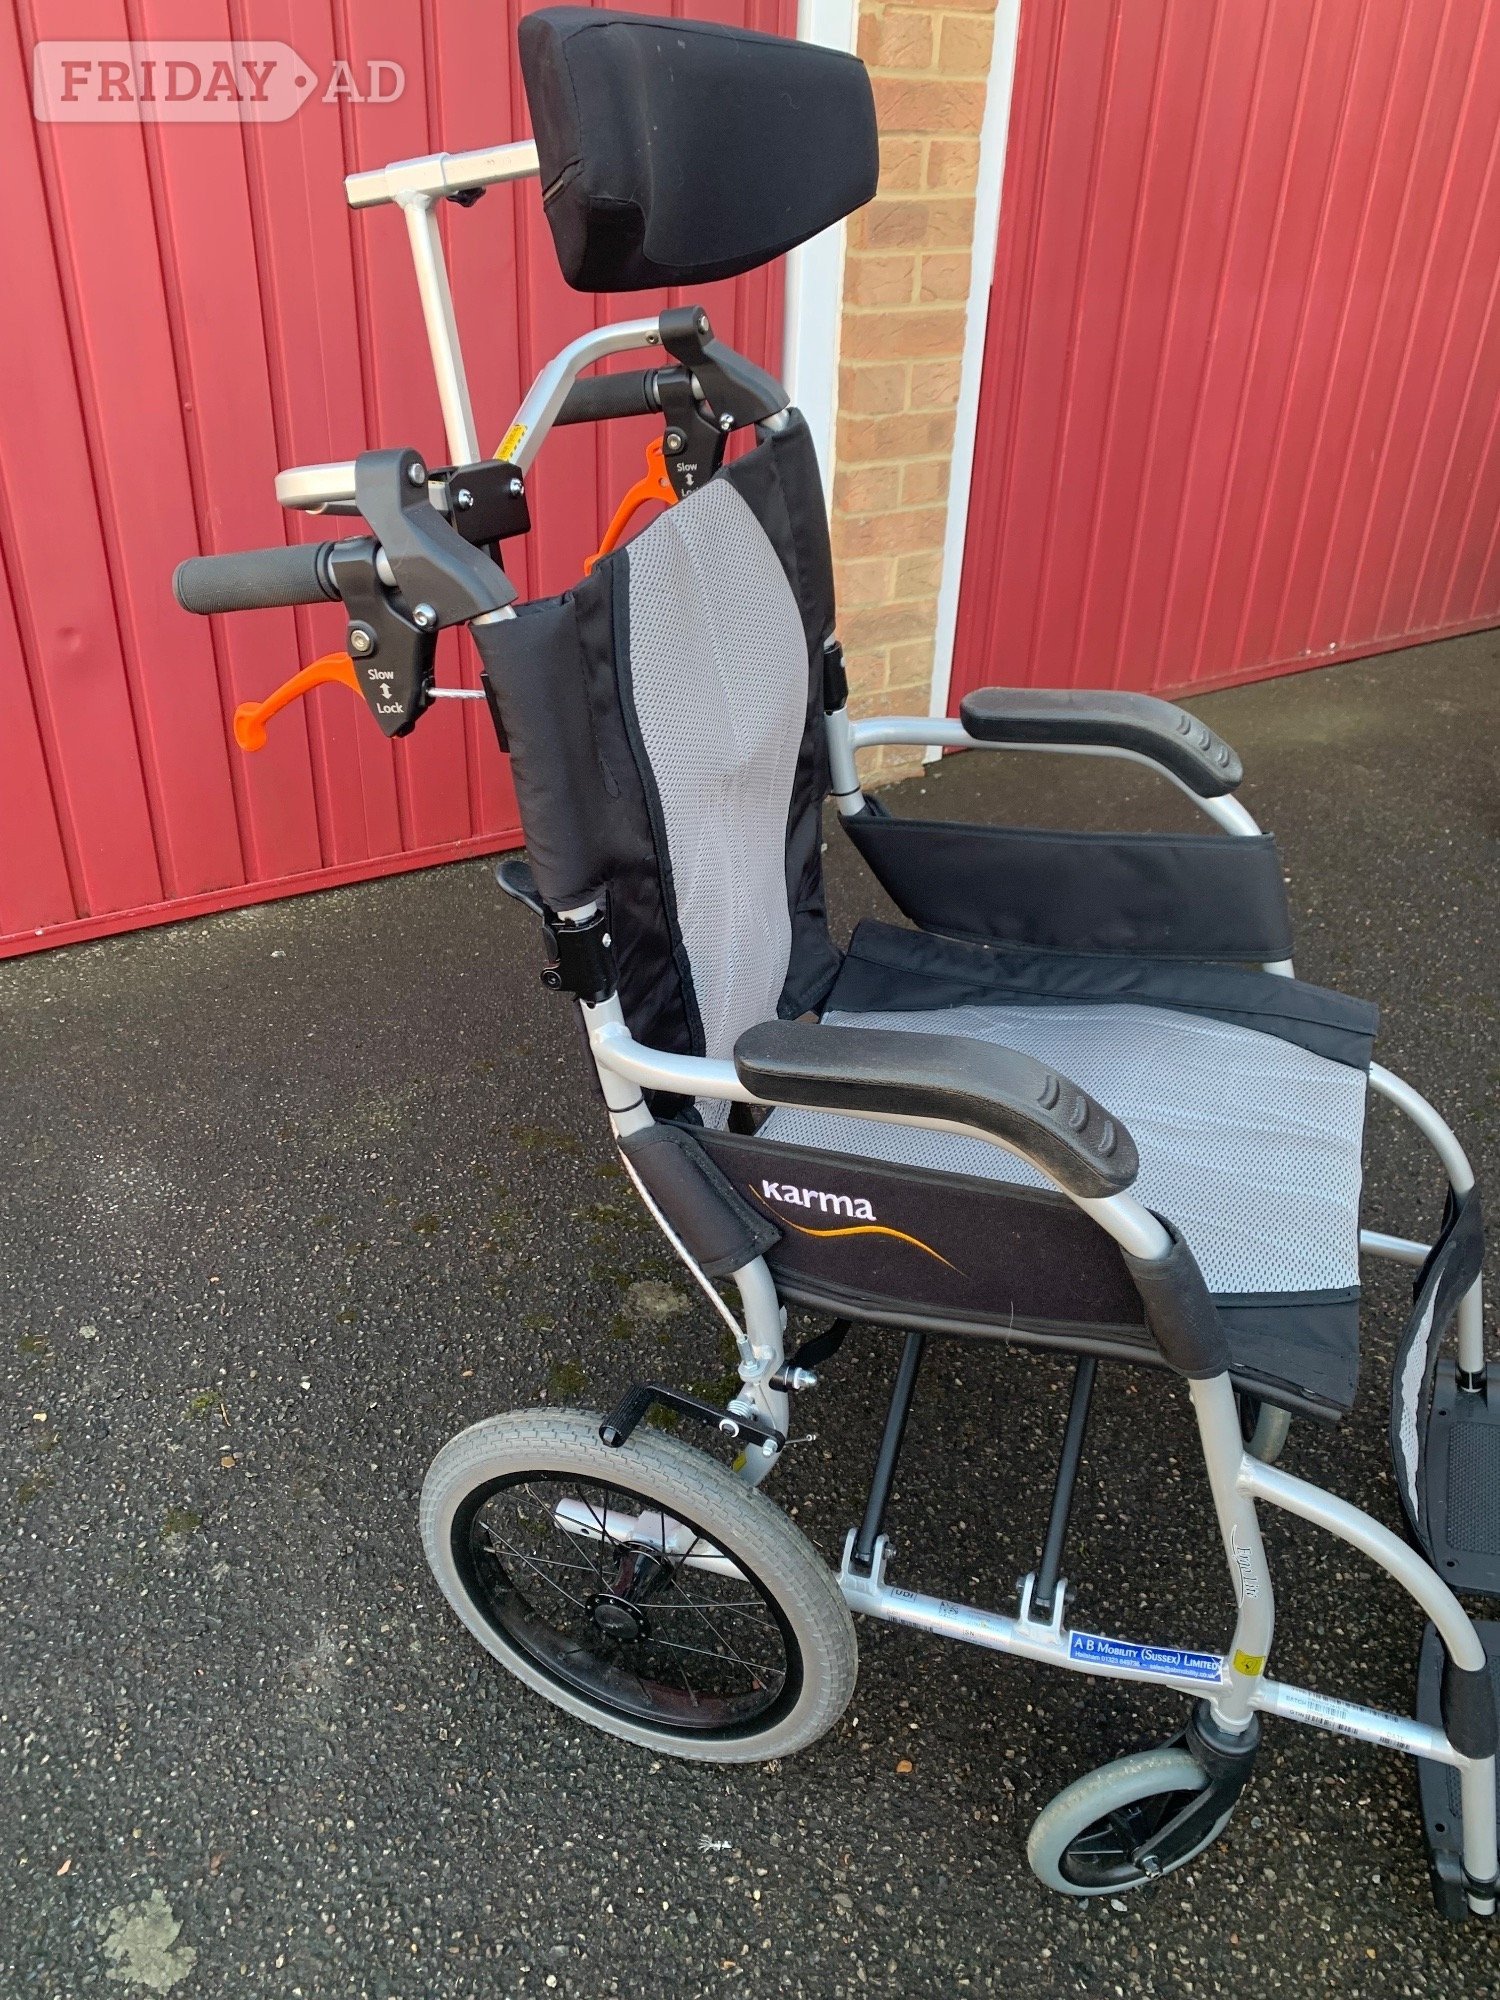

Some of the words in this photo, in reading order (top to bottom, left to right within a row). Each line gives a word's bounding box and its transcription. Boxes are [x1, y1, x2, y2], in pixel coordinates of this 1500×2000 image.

[676, 462, 698, 472] Slow
[367, 668, 394, 680] Slow
[376, 701, 405, 714] Lock
[1073, 1637, 1084, 1650] A
[1086, 1639, 1095, 1652] B
[1183, 1654, 1218, 1671] LIMITED
